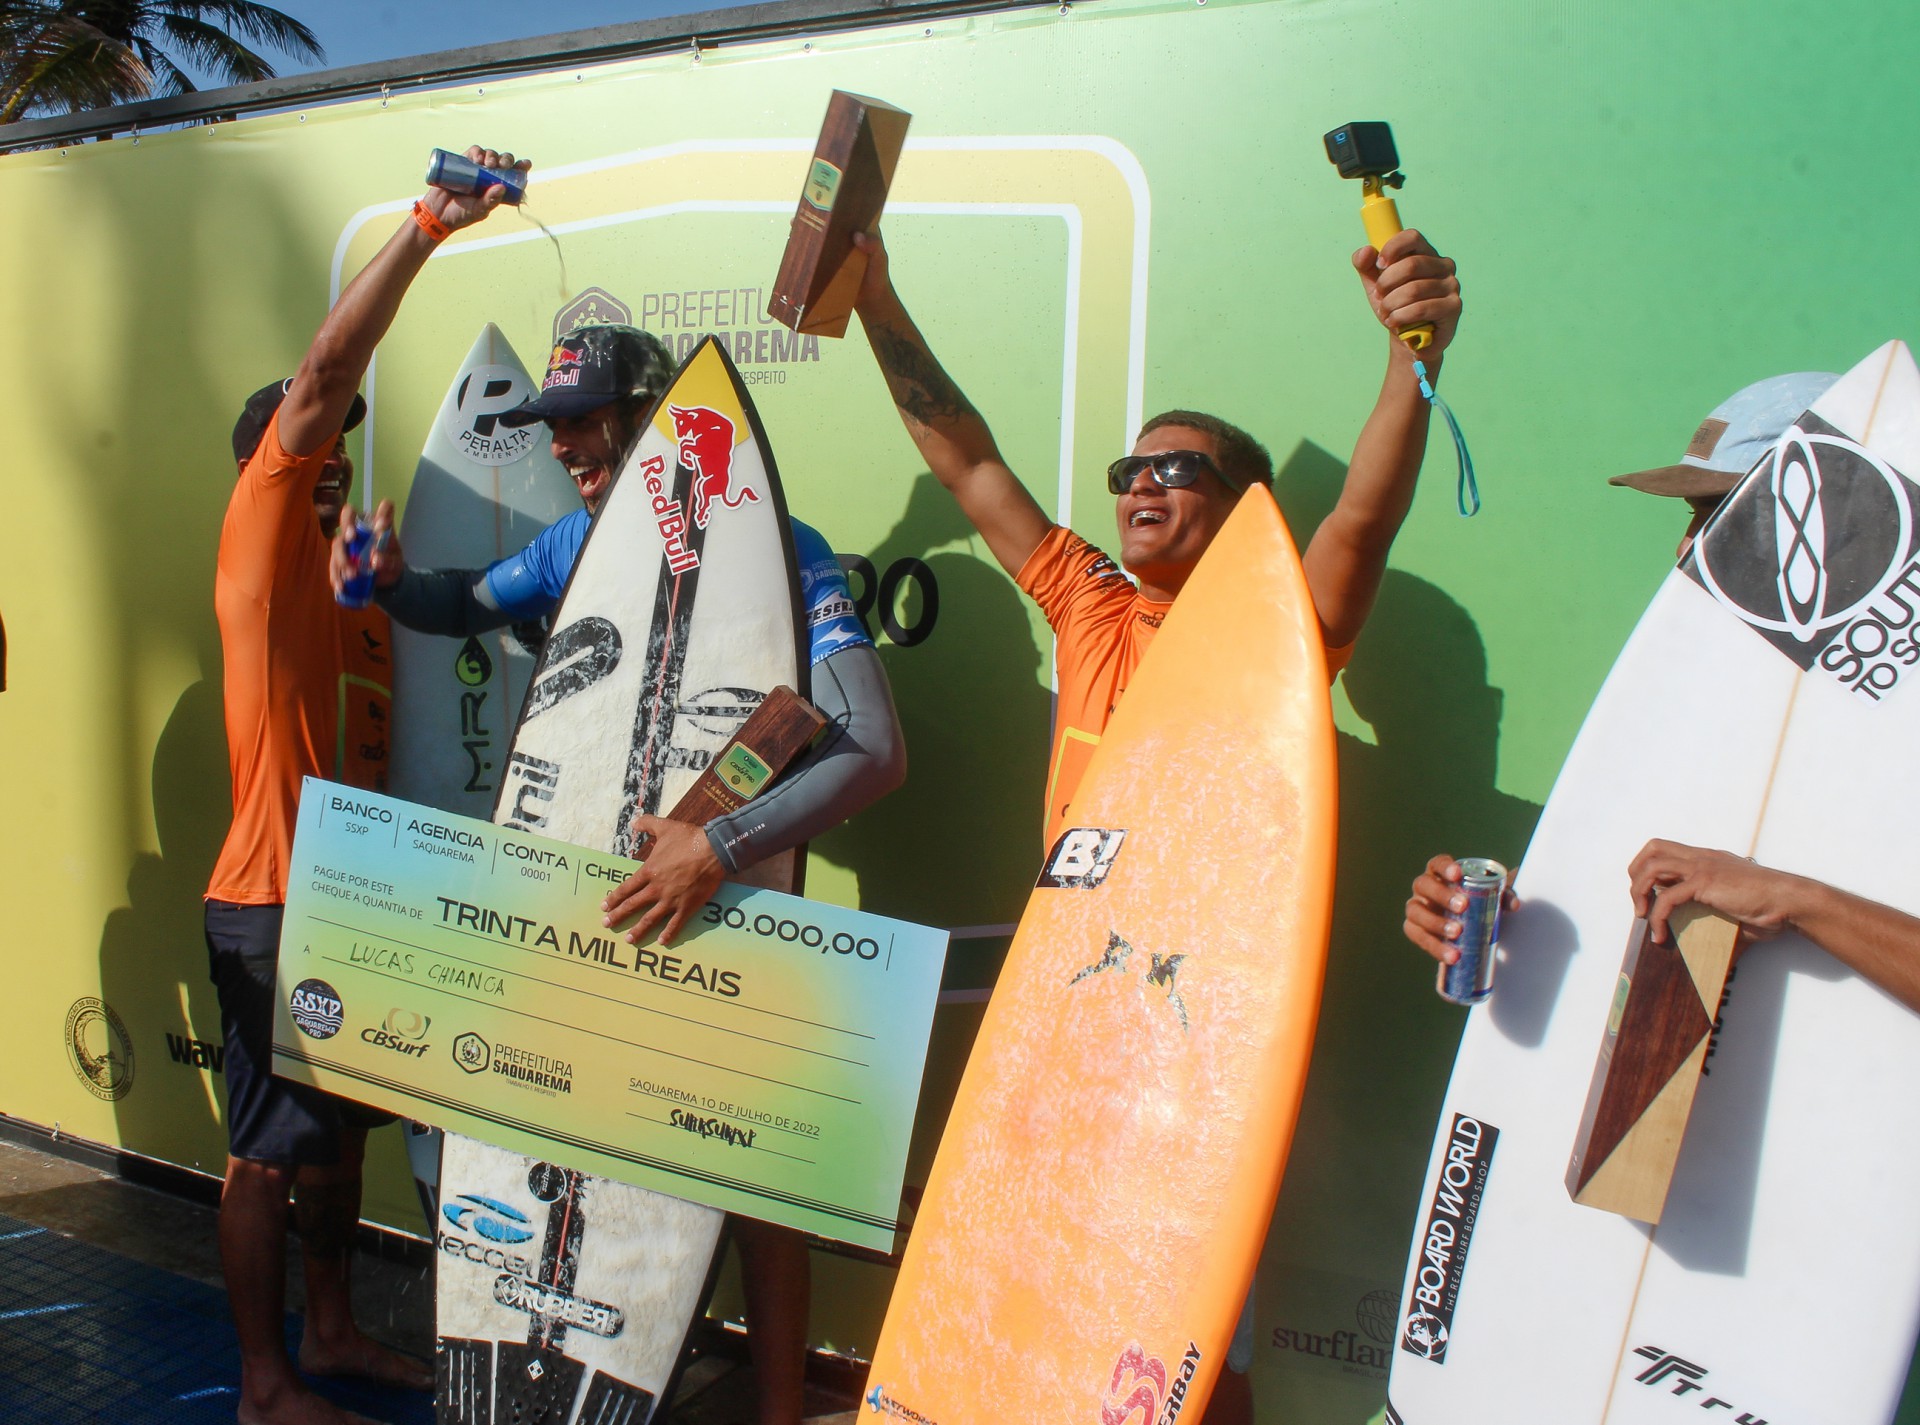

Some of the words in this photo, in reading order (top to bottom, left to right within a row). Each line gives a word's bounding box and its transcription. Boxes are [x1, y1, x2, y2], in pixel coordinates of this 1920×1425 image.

[642, 288, 773, 329] PREFEITU
[460, 430, 530, 452] PERALTA
[1851, 662, 1898, 701] TO
[331, 797, 392, 824] BANCO
[407, 819, 485, 851] AGENCIA
[503, 842, 569, 871] CONTA
[585, 863, 633, 884] CHE
[345, 822, 369, 836] SSXP
[413, 839, 476, 865] SAQUAREMA
[521, 866, 551, 883] 00001
[313, 865, 346, 883] PAGUE
[348, 874, 369, 888] POR
[371, 879, 394, 895] ESTE
[311, 881, 351, 901] CHEQUE
[353, 889, 361, 903] A
[363, 894, 407, 916] QUANTIA
[409, 906, 423, 920] DE
[303, 944, 311, 955] A
[349, 942, 414, 975] LUCAS
[437, 896, 561, 951] TRINTA
[568, 932, 628, 969] MIL
[635, 948, 742, 997] REAIS
[166, 1033, 225, 1073] wav
[361, 1028, 430, 1058] CBSurf
[495, 1043, 573, 1079] PREFEITURA
[493, 1059, 571, 1093] SAQUAREMA
[629, 1077, 697, 1104] SAQUAREMA
[719, 1101, 734, 1114] DE
[736, 1106, 772, 1126] JULHO
[775, 1116, 790, 1128] DE
[793, 1120, 820, 1136] 2022
[1416, 1219, 1455, 1308] BOARD
[1436, 1117, 1482, 1218] WORLD
[1457, 1233, 1469, 1261] SURF
[1450, 1264, 1463, 1291] REAL
[1445, 1292, 1456, 1312] THE
